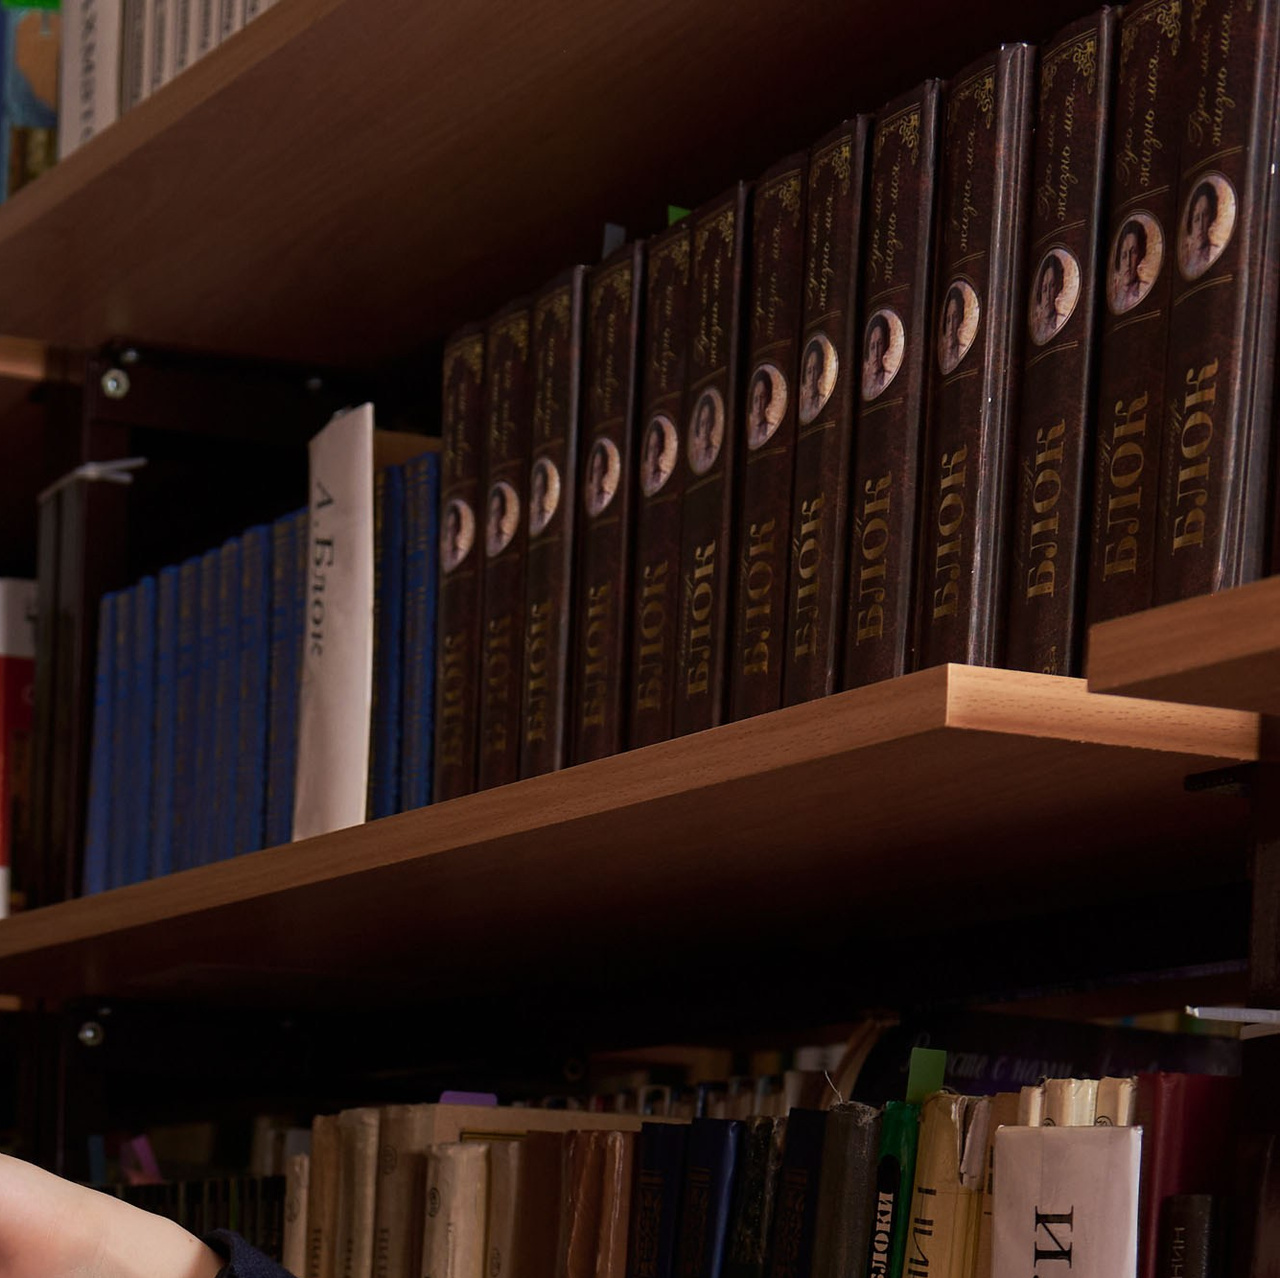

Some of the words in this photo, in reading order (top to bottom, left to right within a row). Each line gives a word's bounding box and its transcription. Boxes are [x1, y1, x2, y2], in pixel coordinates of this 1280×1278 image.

[1139, 109, 1163, 187] жизнь
[1212, 66, 1236, 147] жизнь
[933, 444, 967, 626] БЛОК
[1026, 418, 1066, 605] БЛОК
[1102, 391, 1149, 582] БЛОК
[1172, 358, 1218, 556] БЛОК
[637, 560, 668, 711] БЛОК
[687, 539, 716, 698] БЛОК
[744, 518, 775, 675] БЛОК
[794, 492, 825, 662] БЛОК
[856, 471, 892, 645] БЛОК
